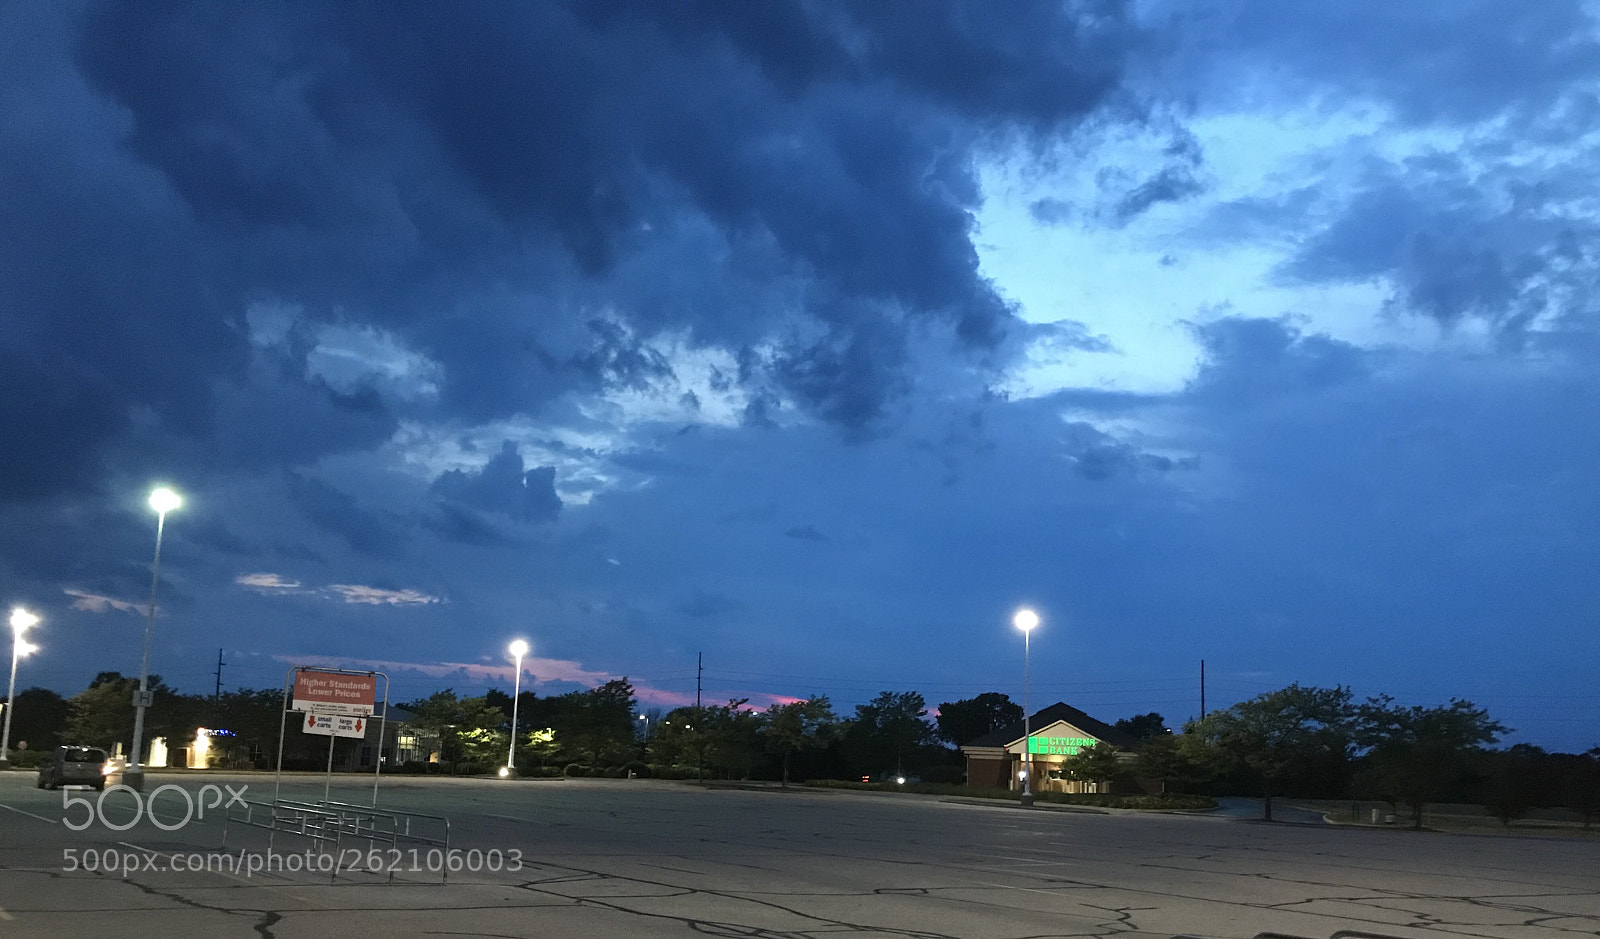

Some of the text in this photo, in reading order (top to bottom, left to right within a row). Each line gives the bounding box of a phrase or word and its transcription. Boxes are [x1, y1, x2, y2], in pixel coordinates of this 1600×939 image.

[300, 678, 371, 690] Higher Standards
[335, 690, 361, 698] Prices
[1049, 737, 1096, 747] CITIZENS
[1049, 746, 1078, 755] BANK
